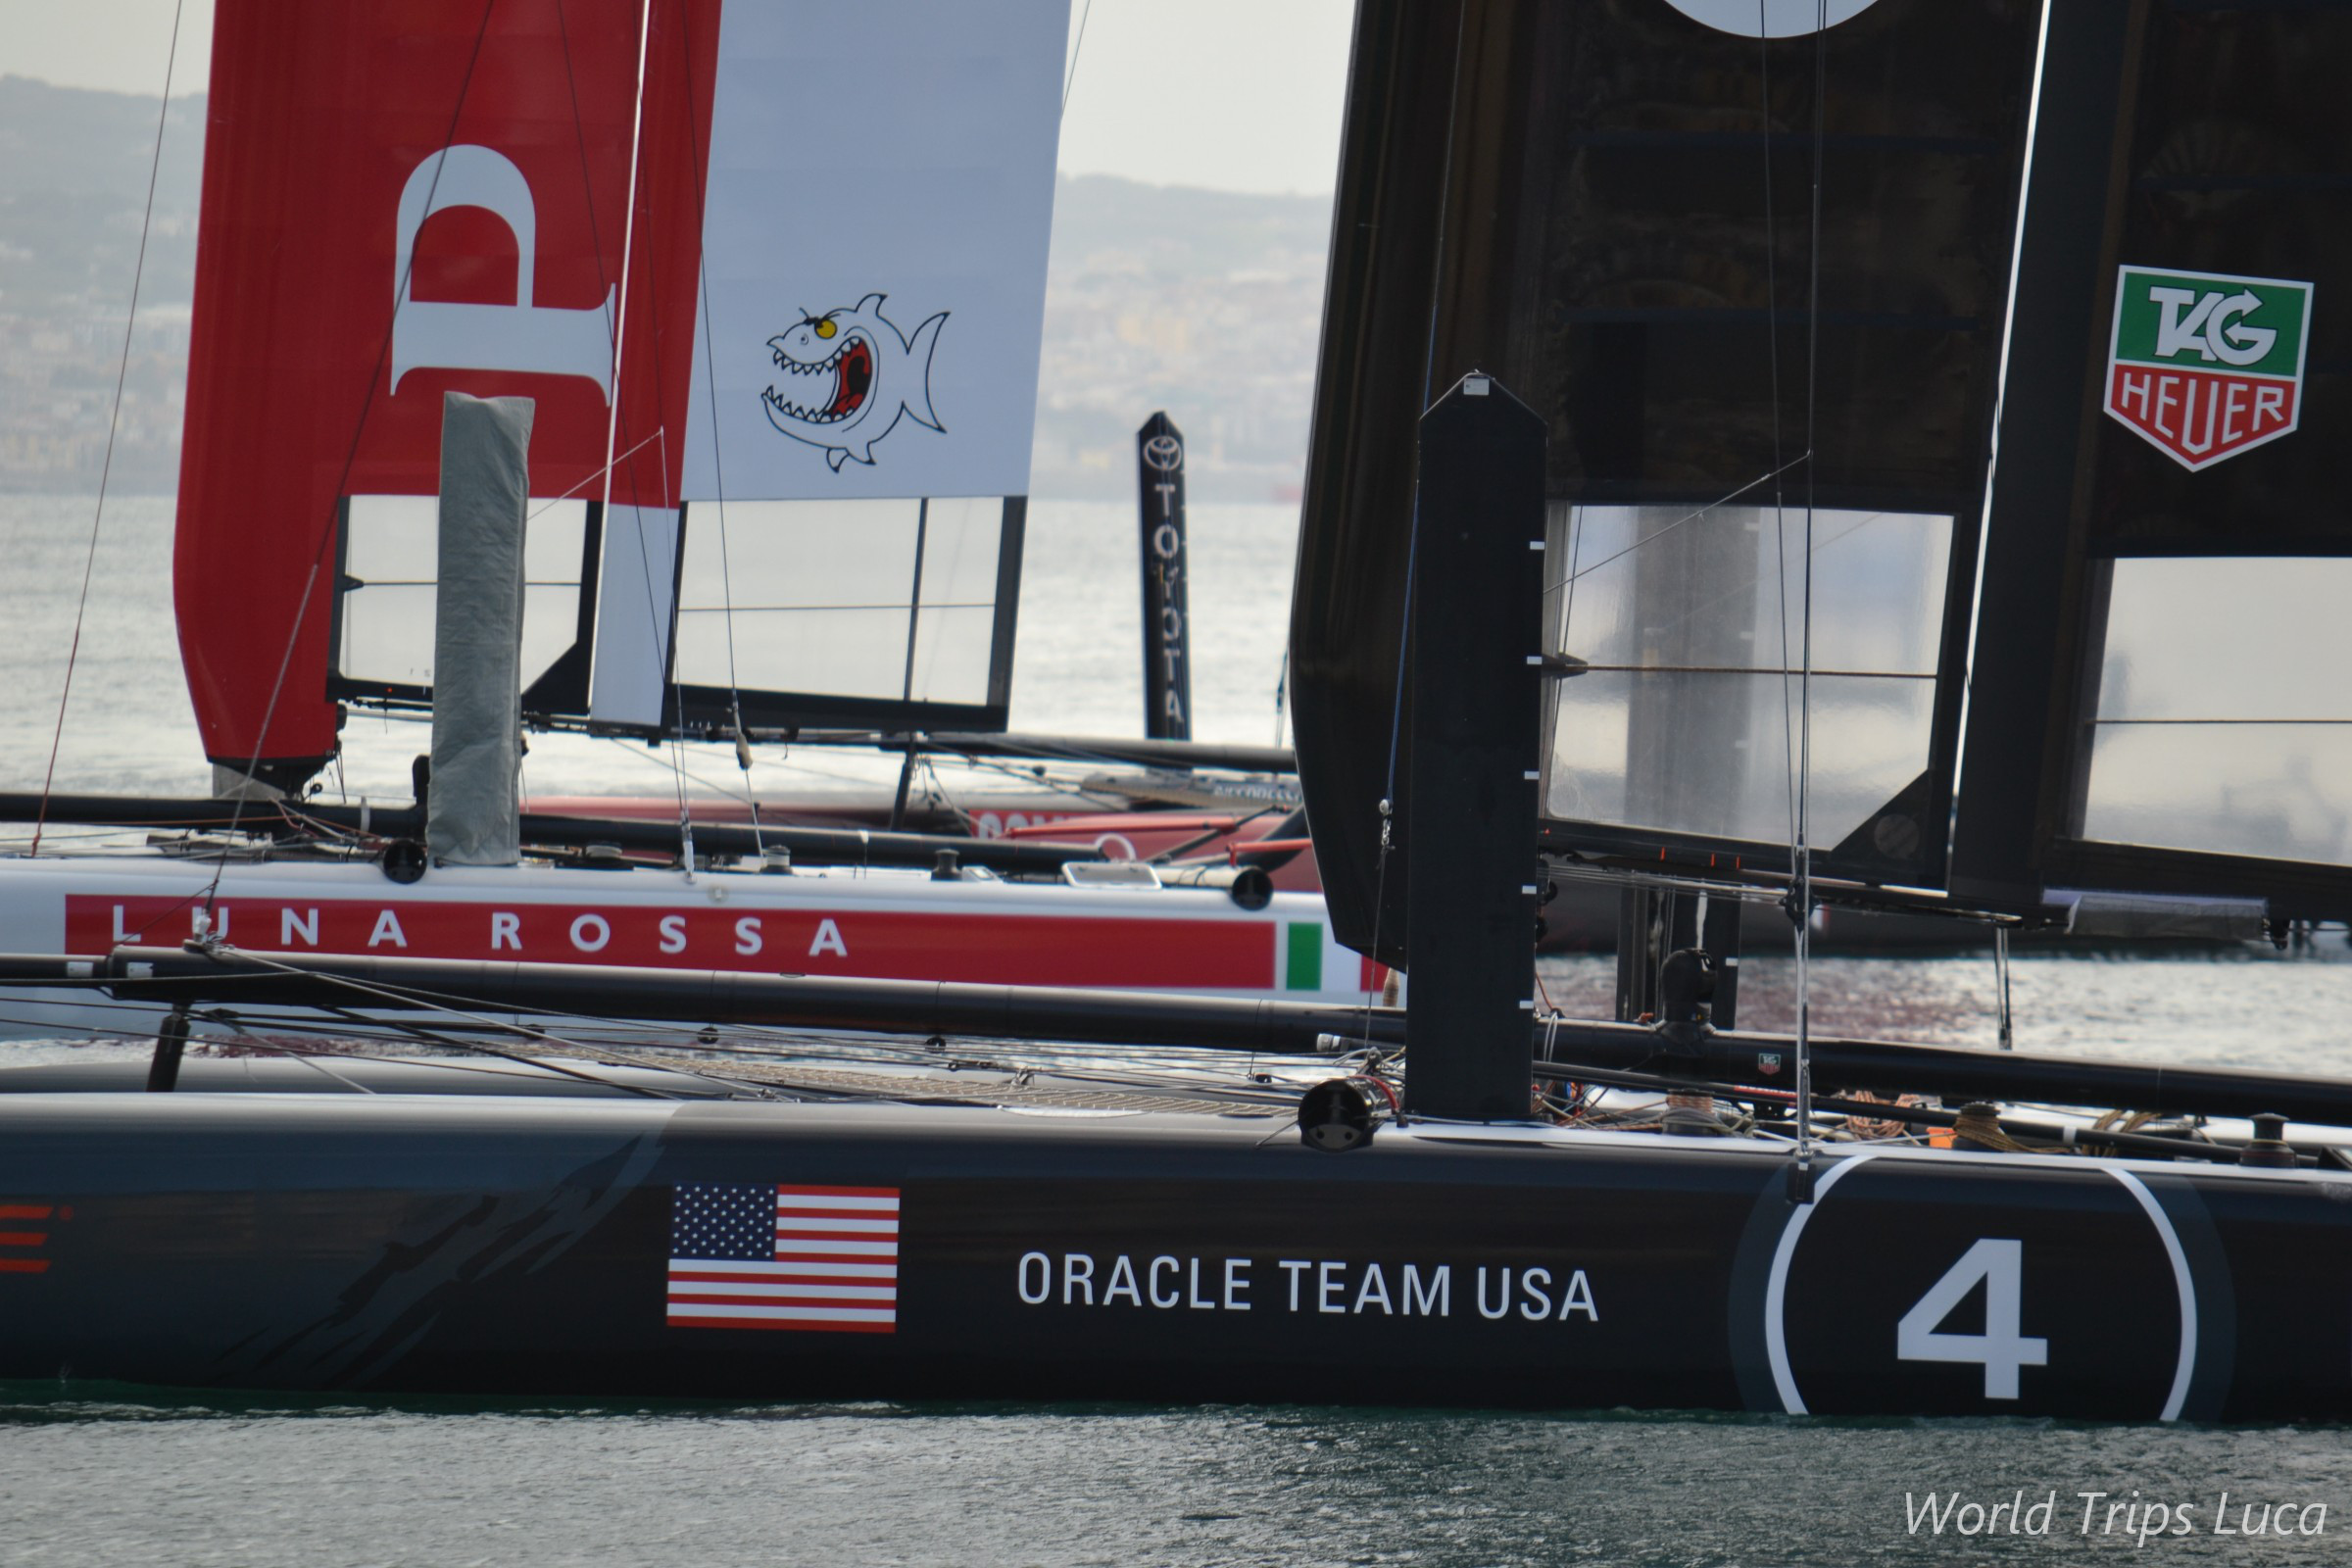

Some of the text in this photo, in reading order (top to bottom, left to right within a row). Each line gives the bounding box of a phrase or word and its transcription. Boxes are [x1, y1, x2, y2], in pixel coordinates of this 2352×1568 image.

[2149, 284, 2278, 367] TAG
[2121, 371, 2284, 456] HEUER
[1152, 482, 1185, 723] TOYOTA
[113, 905, 848, 957] LUNA ROSSA
[1018, 1251, 1598, 1322] ORACLE TEAM USA
[1897, 1238, 2047, 1399] 4
